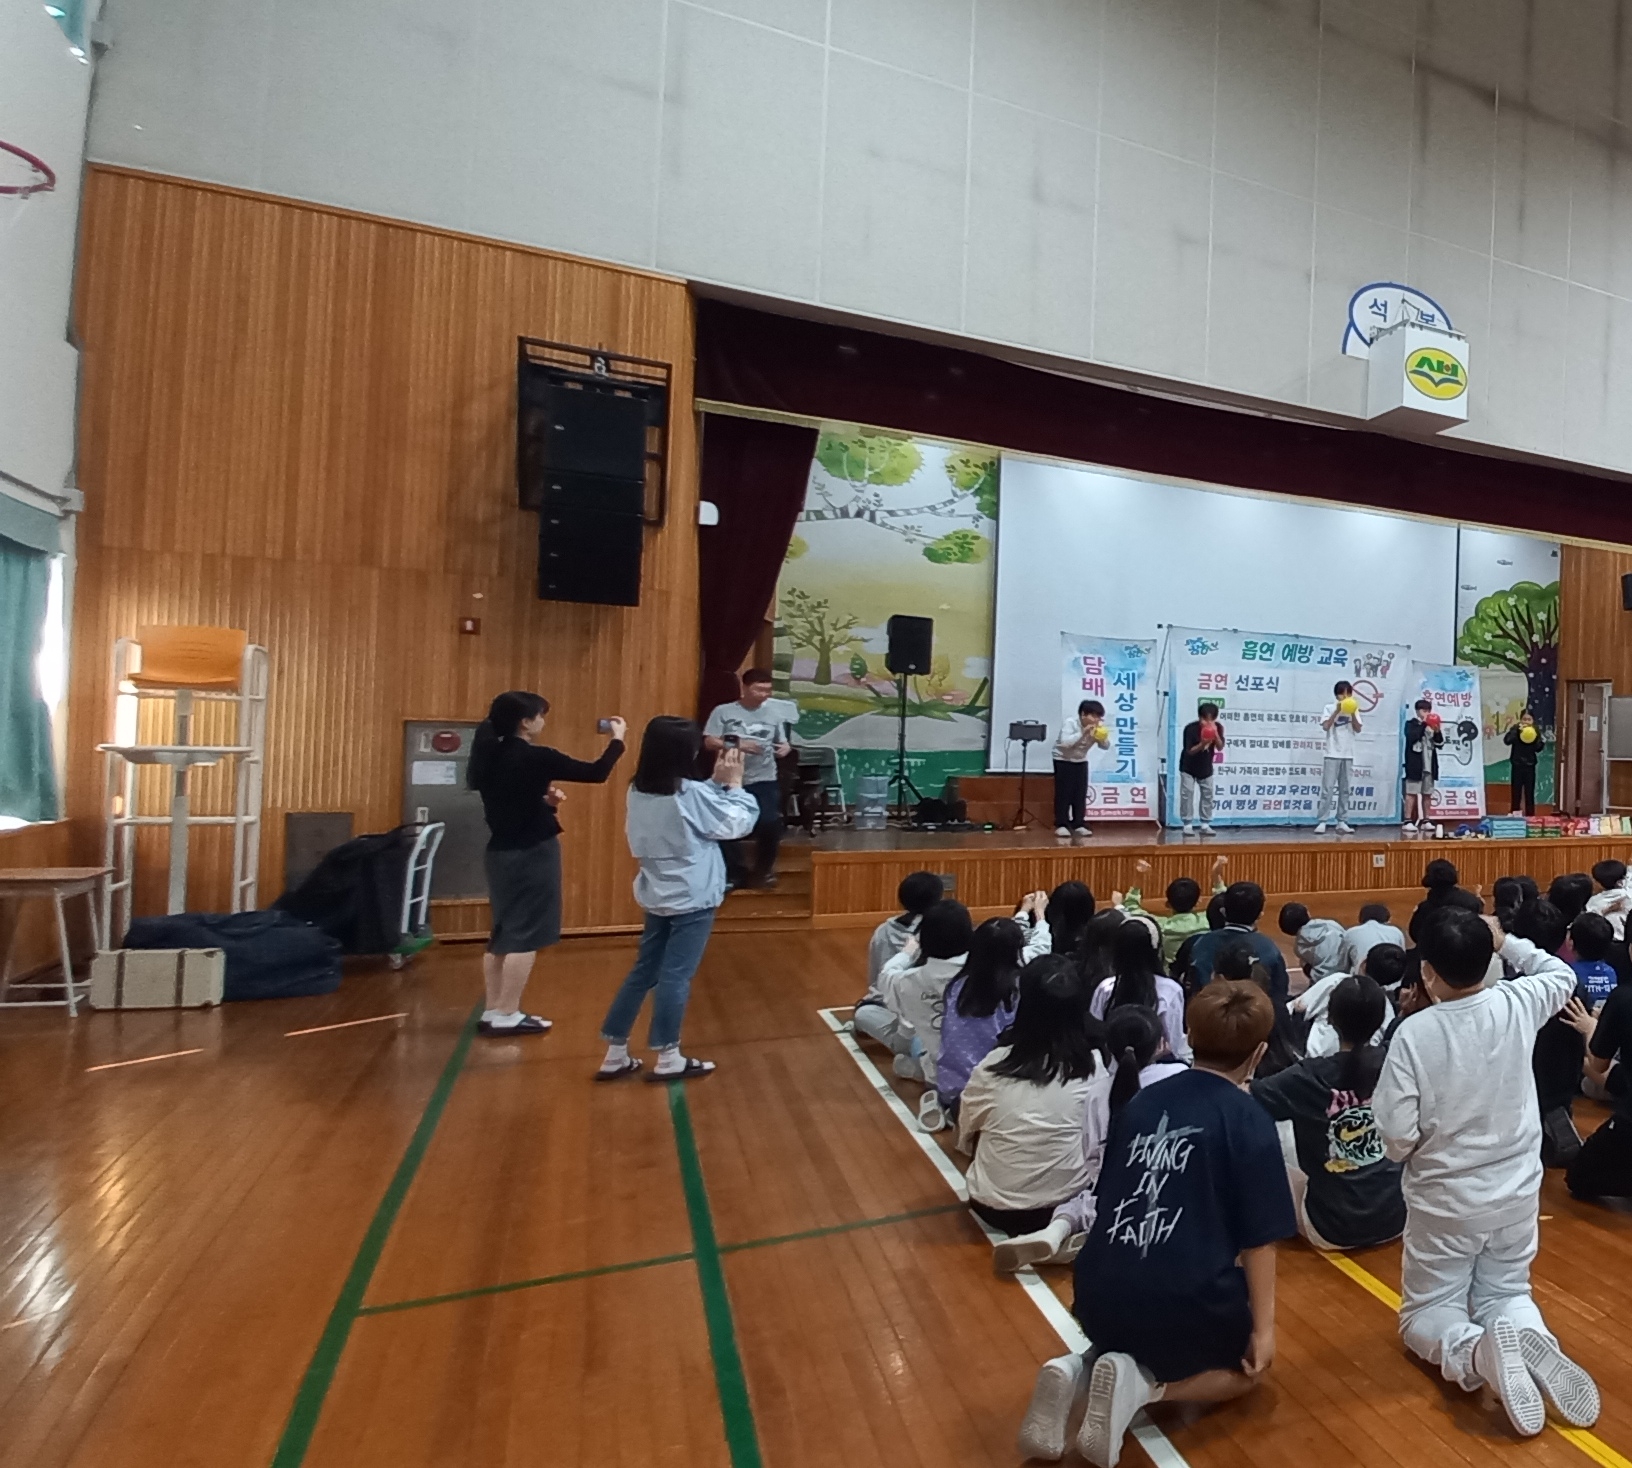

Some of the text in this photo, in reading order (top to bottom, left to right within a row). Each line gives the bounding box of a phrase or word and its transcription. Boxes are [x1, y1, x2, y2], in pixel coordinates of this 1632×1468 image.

[1241, 640, 1275, 662] 흡연
[1281, 643, 1315, 664] 예방
[1317, 647, 1348, 667] 교육
[1082, 655, 1105, 697] 담배
[1197, 673, 1280, 693] 금연 선포식
[1229, 784, 1251, 796] 나의
[1132, 1171, 1170, 1203] IN
[1106, 1198, 1183, 1248] FAITH
